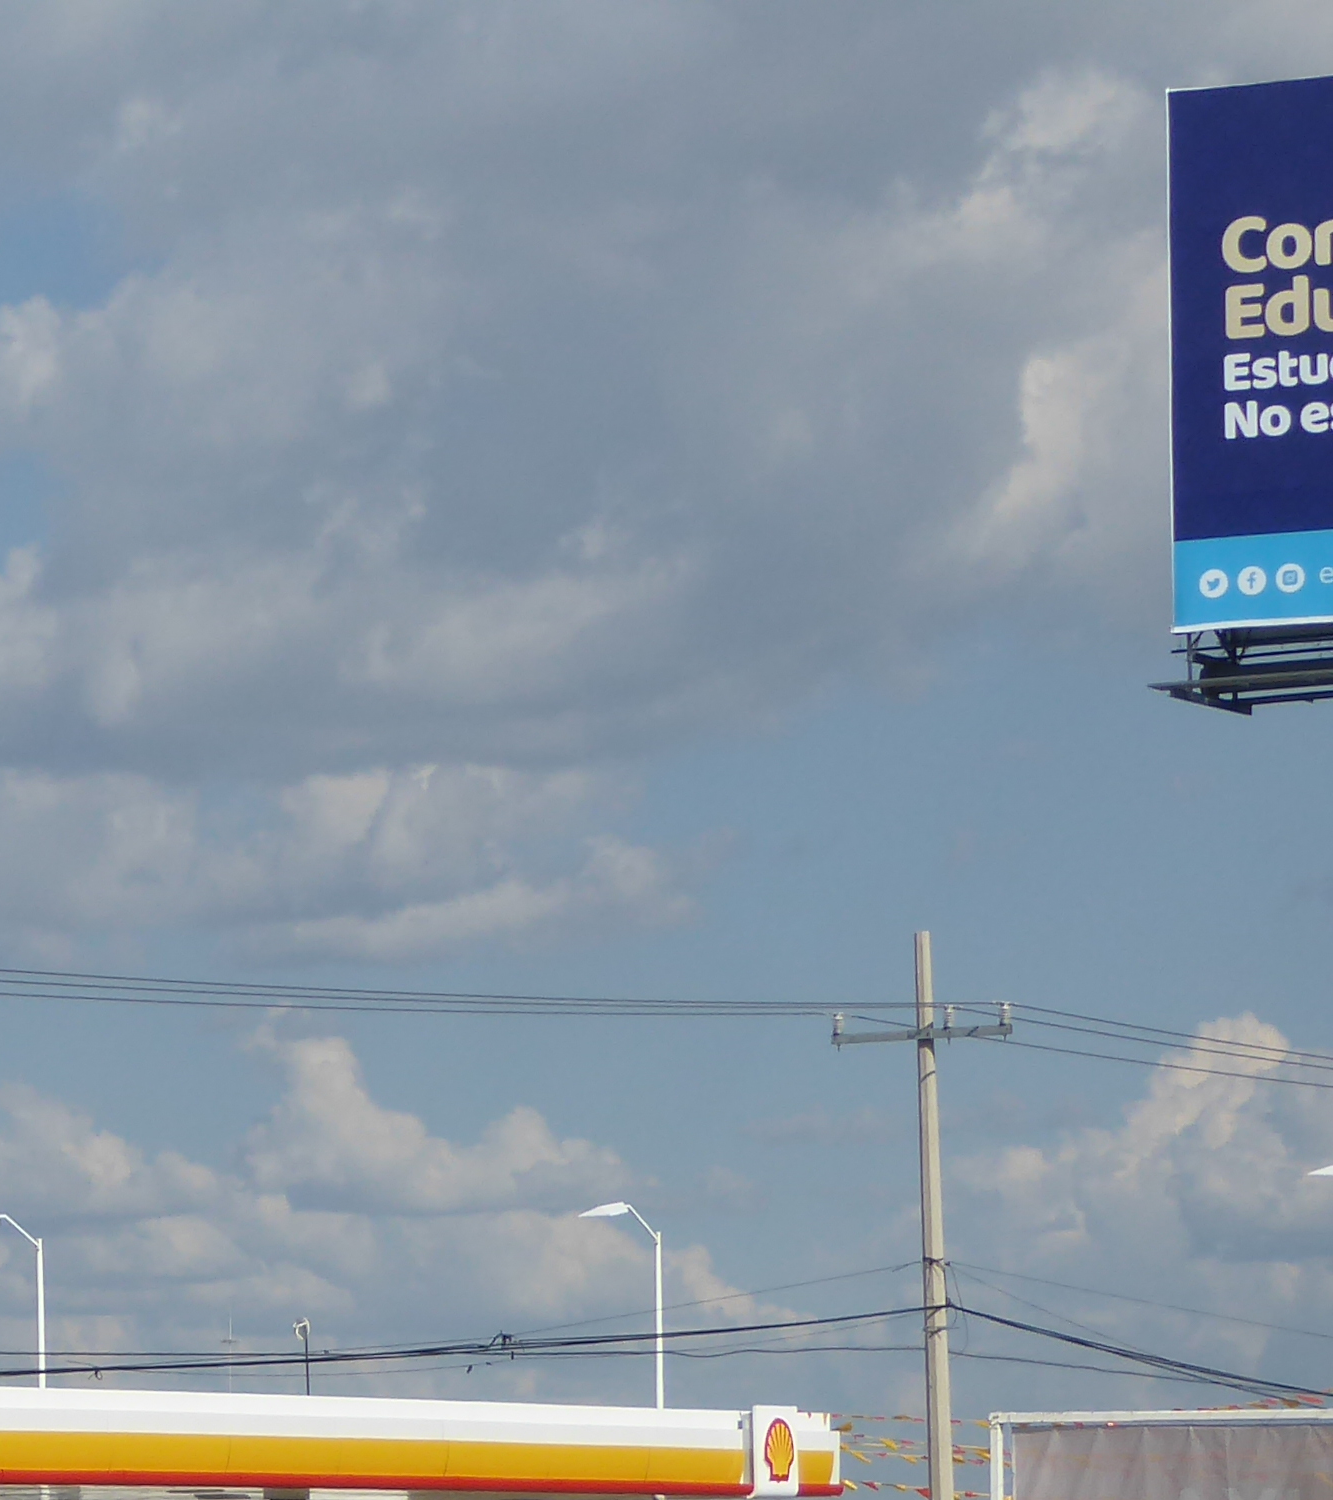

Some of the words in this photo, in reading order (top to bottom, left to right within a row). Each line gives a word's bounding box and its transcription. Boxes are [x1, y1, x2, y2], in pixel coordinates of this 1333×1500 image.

[1223, 350, 1333, 391] Estu
[1224, 400, 1292, 439] No
[1299, 401, 1333, 433] e
